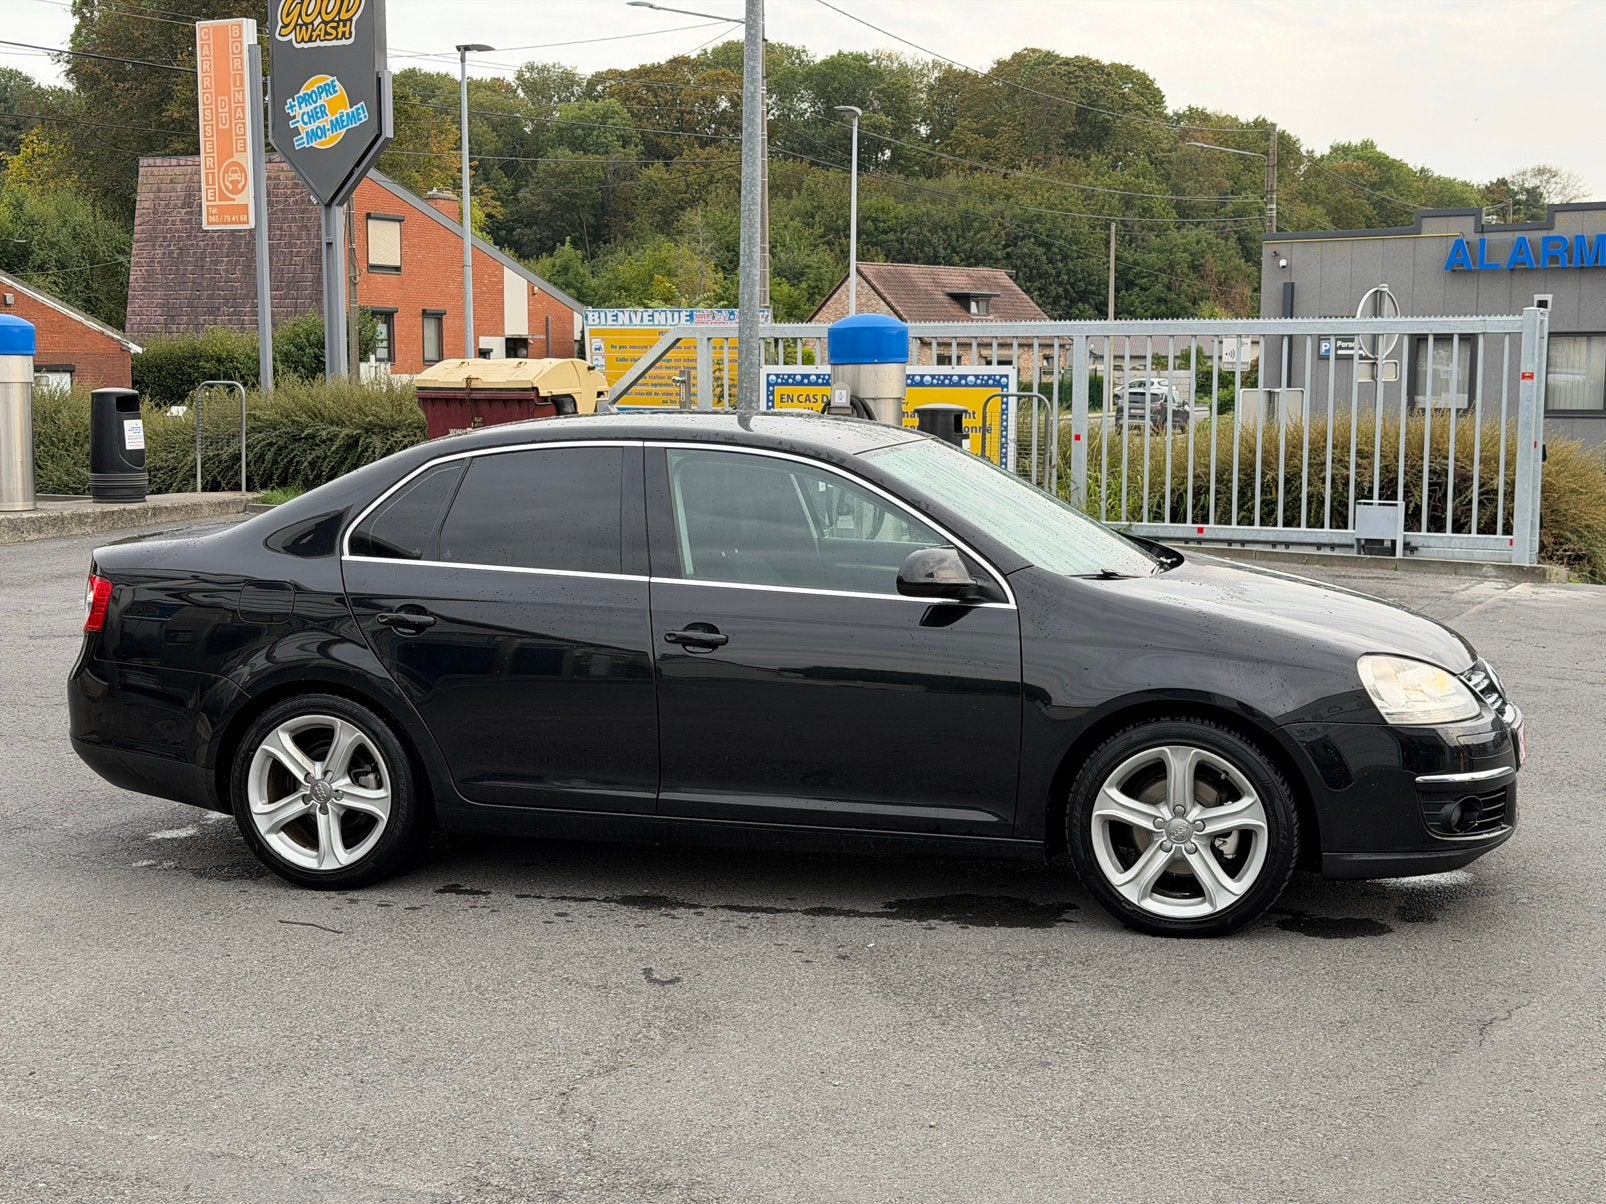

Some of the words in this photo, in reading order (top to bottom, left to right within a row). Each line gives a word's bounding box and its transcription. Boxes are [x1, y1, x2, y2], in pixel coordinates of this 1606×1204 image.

[280, 0, 361, 35] GOOD
[296, 21, 351, 42] WASH
[231, 25, 246, 151] BORINAGE
[201, 28, 216, 200] CARROSSERIE
[218, 97, 229, 128] DU
[1444, 233, 1606, 271] ALARM
[587, 310, 694, 325] BIENVENUE
[780, 394, 794, 404] EN
[797, 394, 818, 404] CAS
